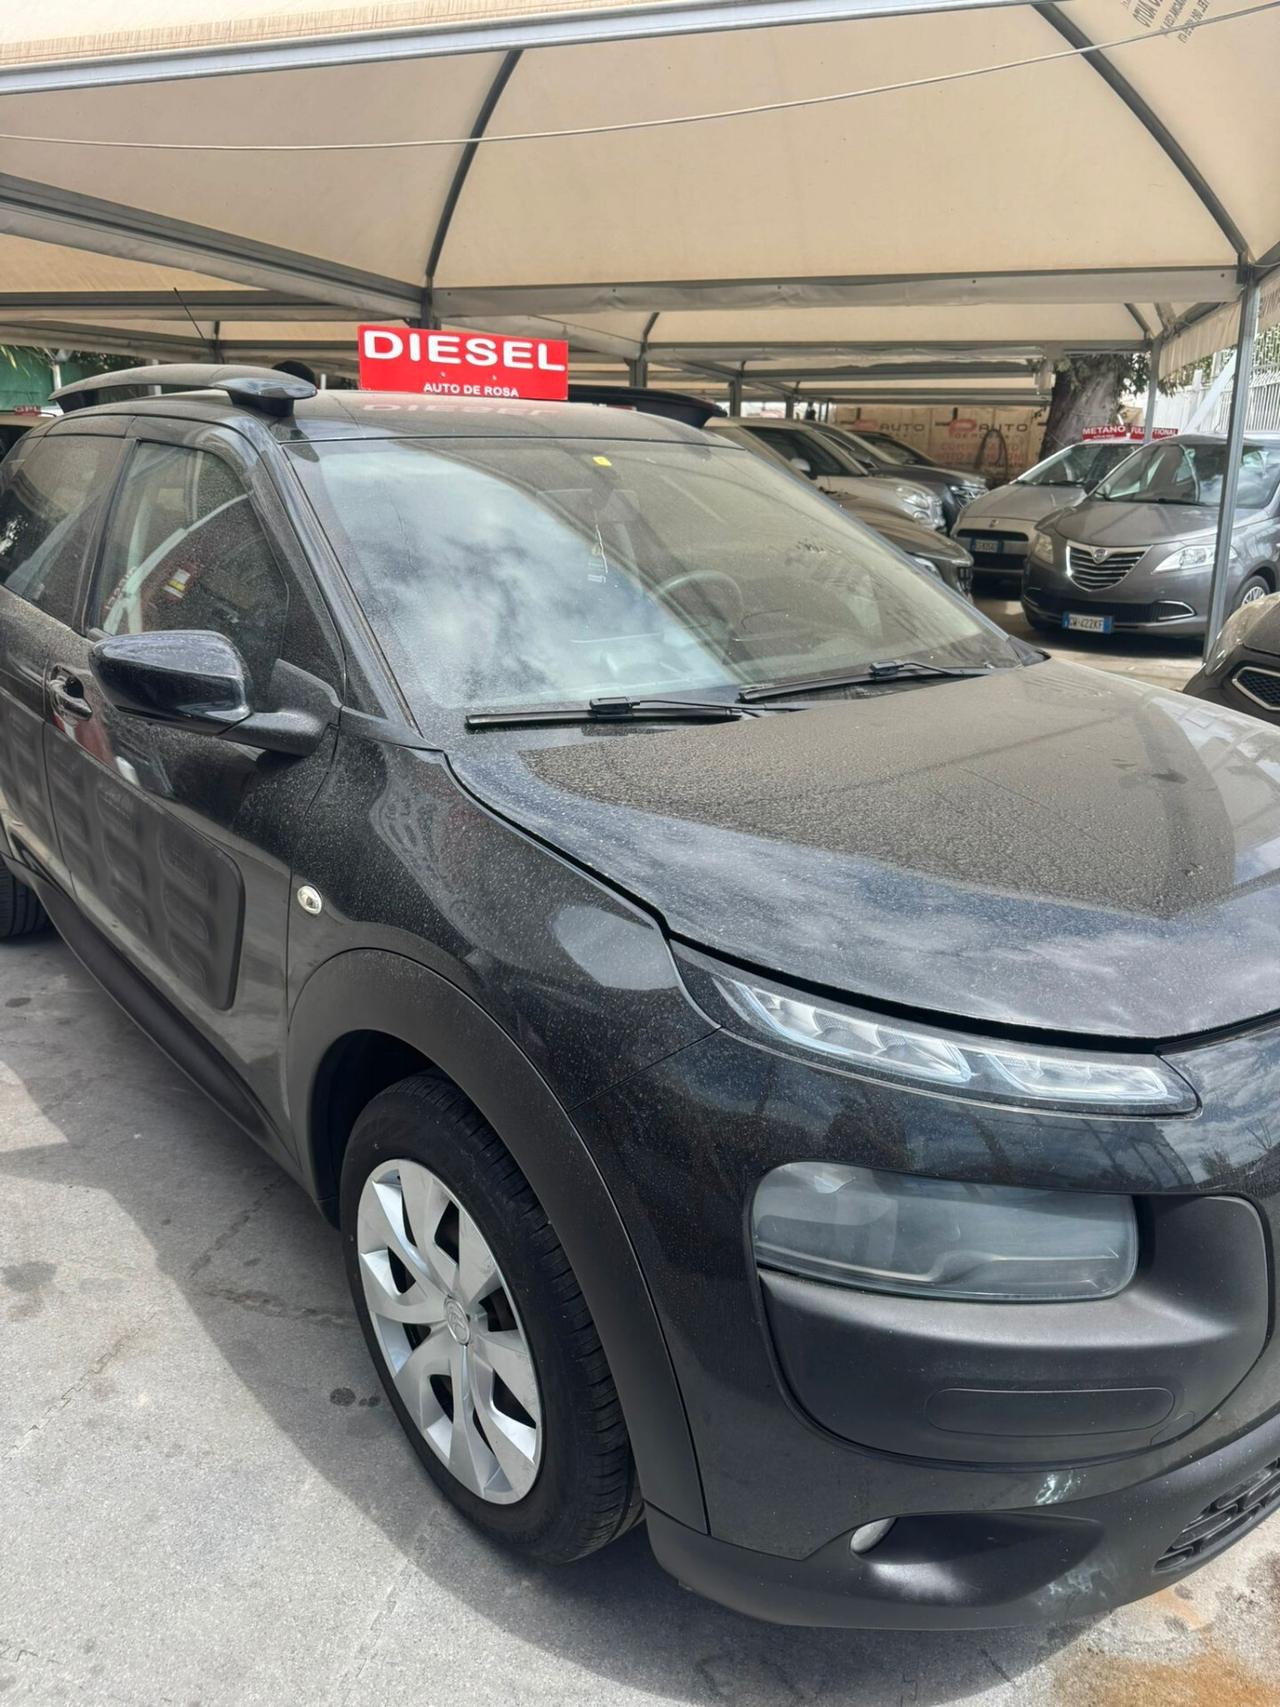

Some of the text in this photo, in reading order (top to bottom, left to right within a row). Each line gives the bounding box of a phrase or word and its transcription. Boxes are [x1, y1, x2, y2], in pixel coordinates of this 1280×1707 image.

[363, 330, 566, 371] DIESEL
[423, 382, 519, 398] AUTO DE ROSA
[880, 423, 925, 432] AUTO
[979, 423, 1028, 433] AUTO
[1082, 425, 1126, 435] METANO
